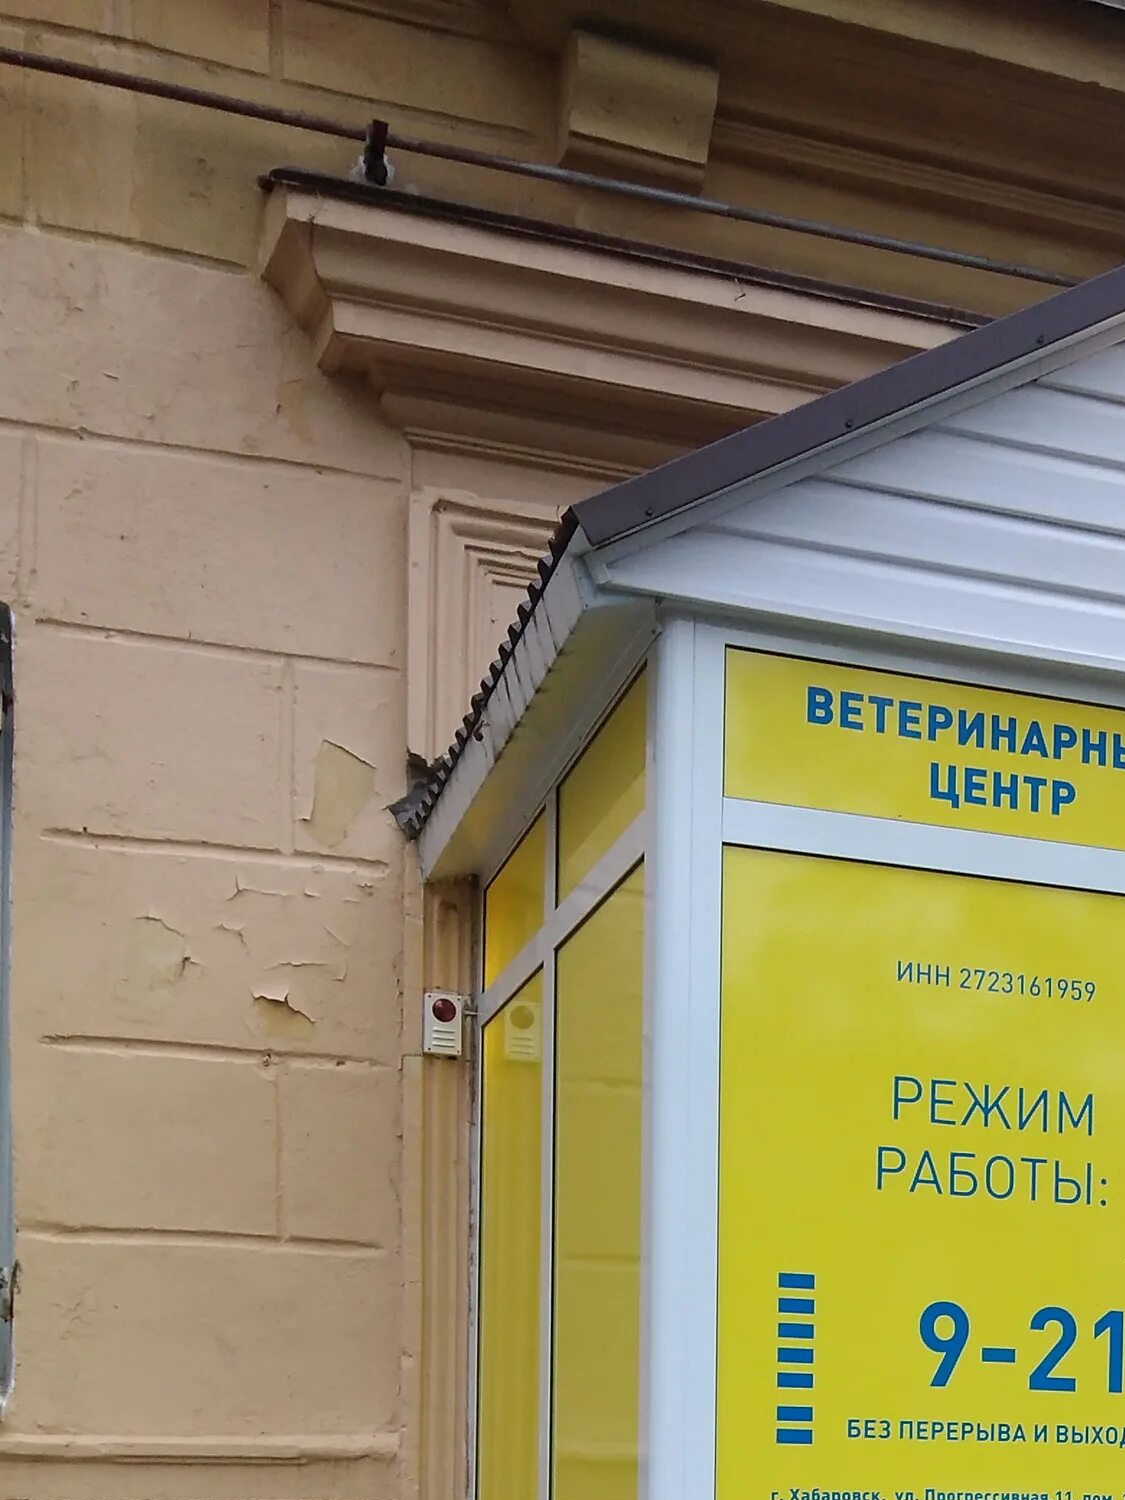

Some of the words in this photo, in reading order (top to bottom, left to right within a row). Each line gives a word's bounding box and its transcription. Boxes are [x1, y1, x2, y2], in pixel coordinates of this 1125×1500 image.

[929, 762, 1076, 817] ЦЕНТР
[897, 960, 950, 987] ИНН
[959, 968, 1096, 1002] 2723161959
[892, 1075, 1094, 1136] РЕЖИМ
[876, 1145, 1108, 1207] РАБОТЫ:
[918, 1300, 1125, 1394] 9-21
[847, 1418, 891, 1439] БЕЗ
[899, 1420, 1027, 1442] ПЕРЕРЫВА
[1034, 1424, 1048, 1443] И
